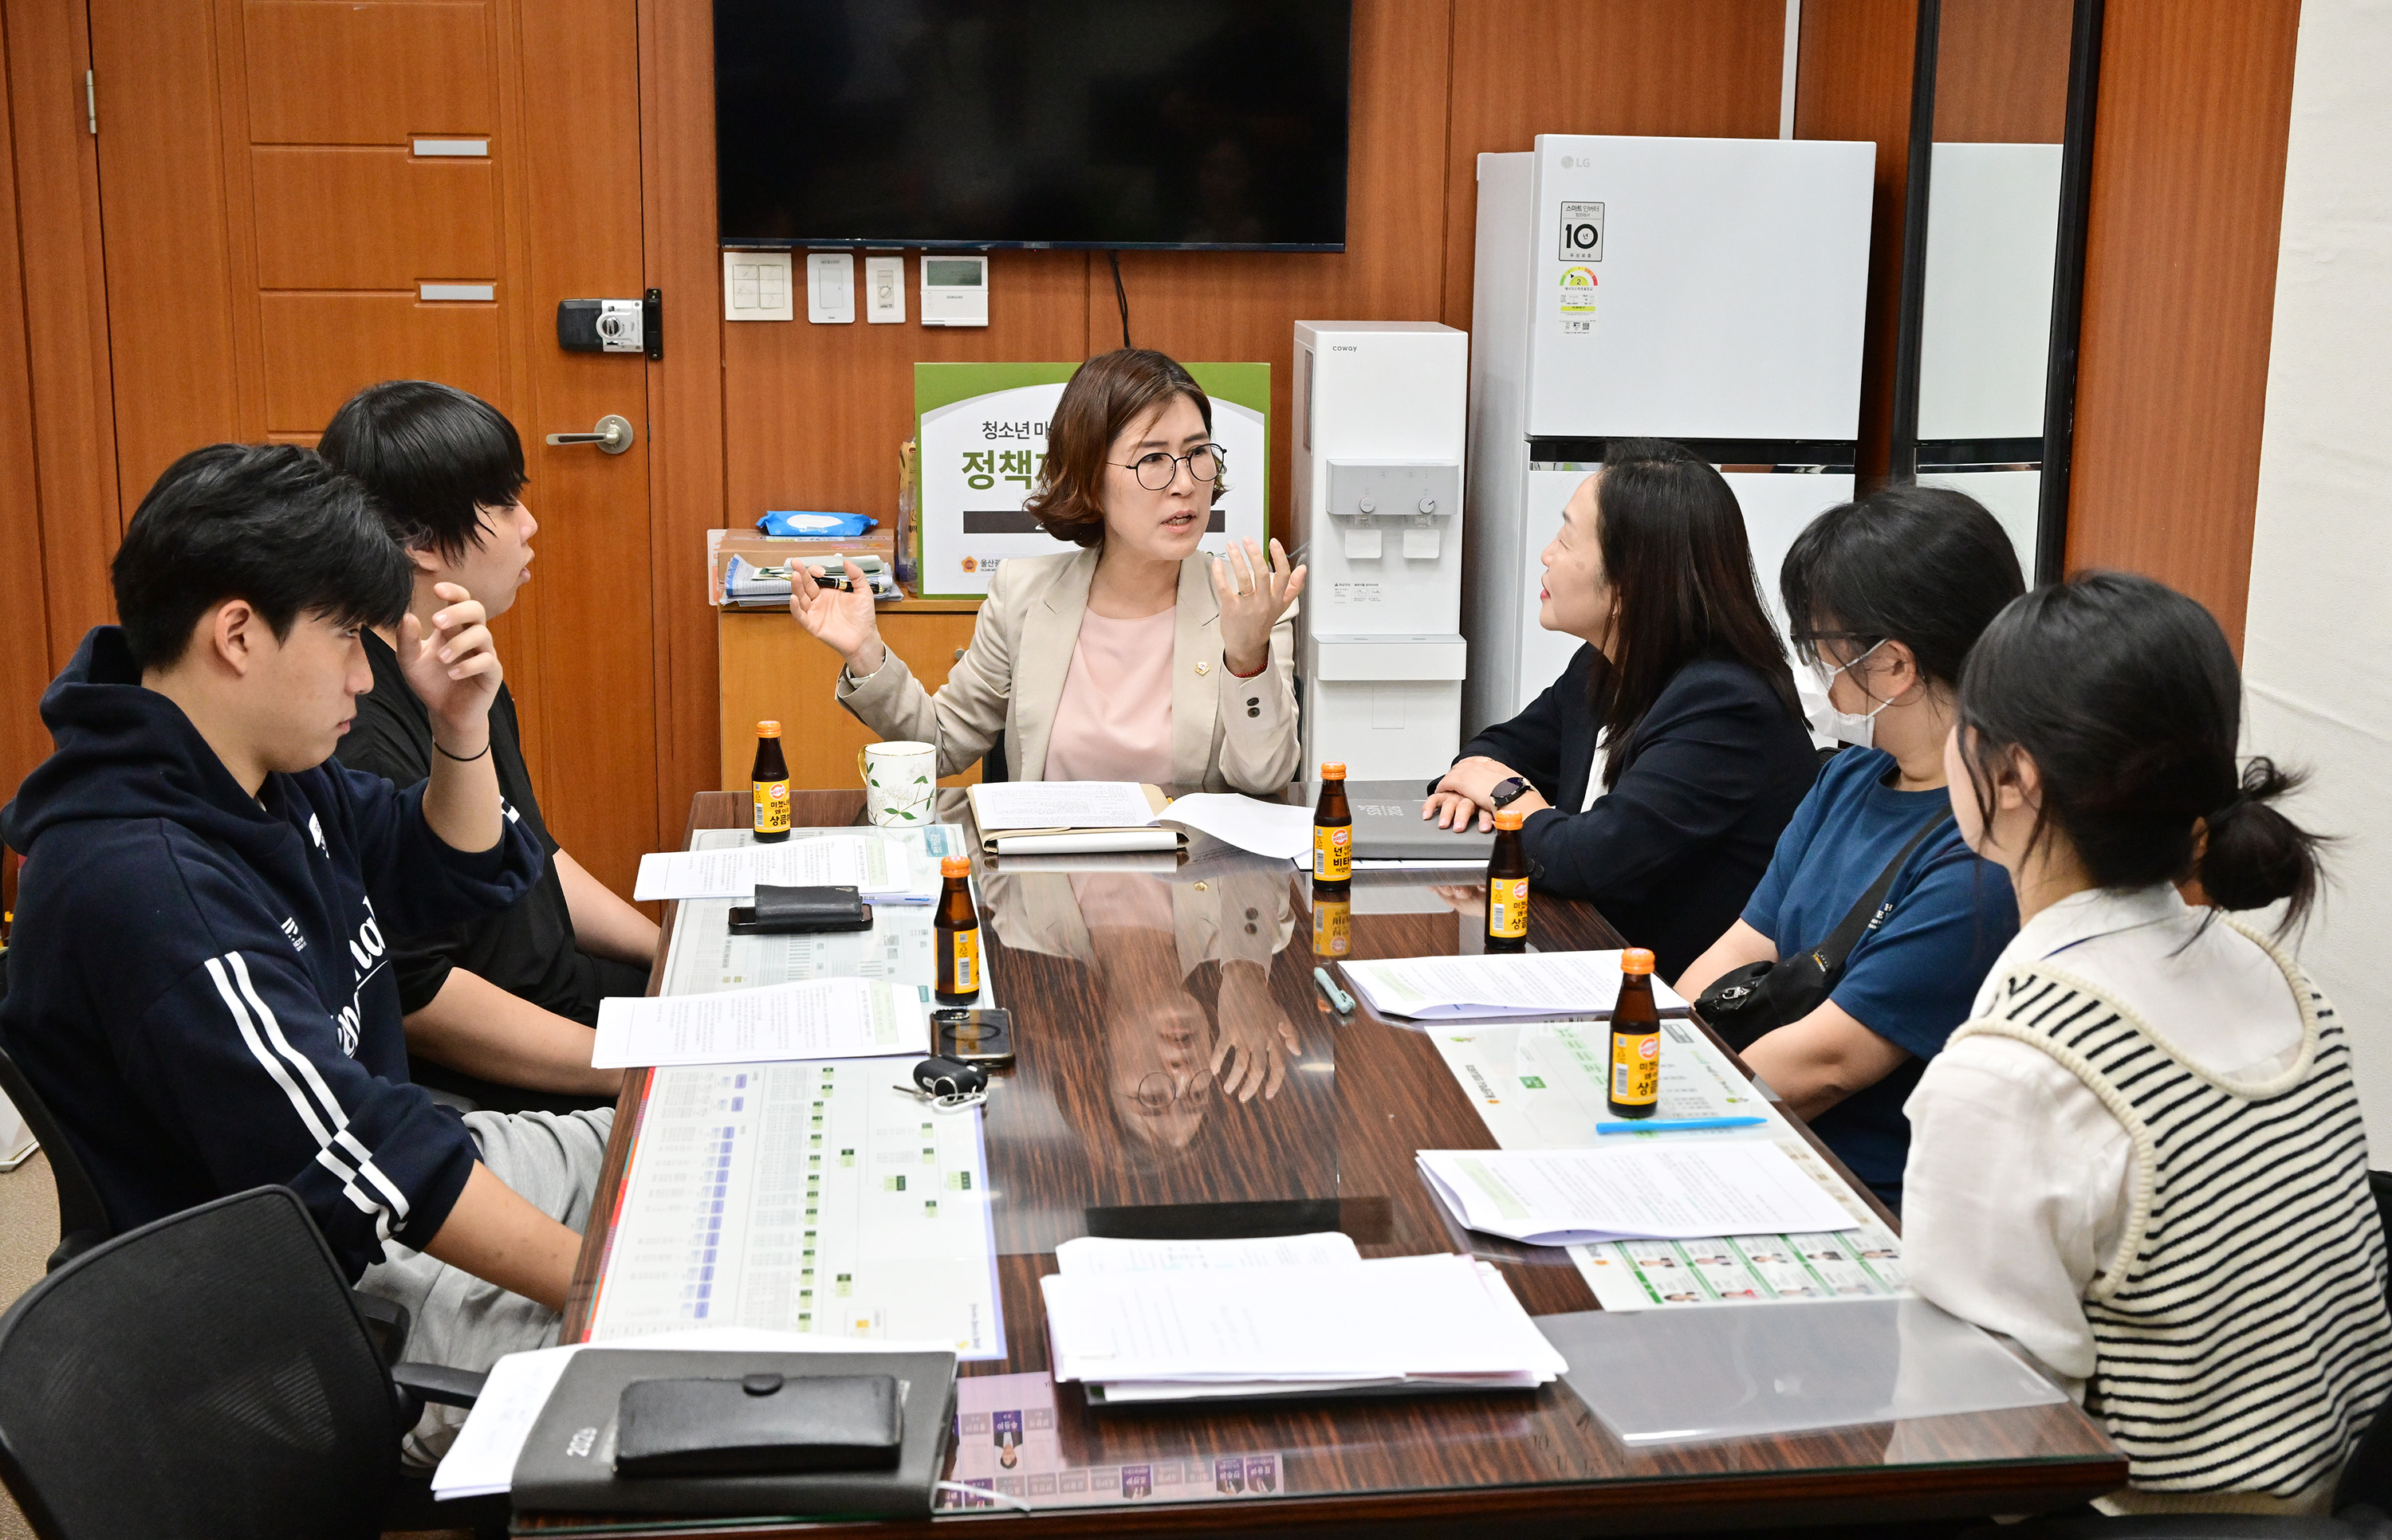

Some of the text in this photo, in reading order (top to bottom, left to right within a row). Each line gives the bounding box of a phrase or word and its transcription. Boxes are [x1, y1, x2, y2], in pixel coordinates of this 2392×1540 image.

[1576, 157, 1591, 167] LG
[1565, 224, 1599, 249] 10
[982, 421, 1051, 440] 청소년 마
[981, 559, 1001, 568] 울산광
[1333, 847, 1343, 857] 넌
[1333, 856, 1351, 866] 비타
